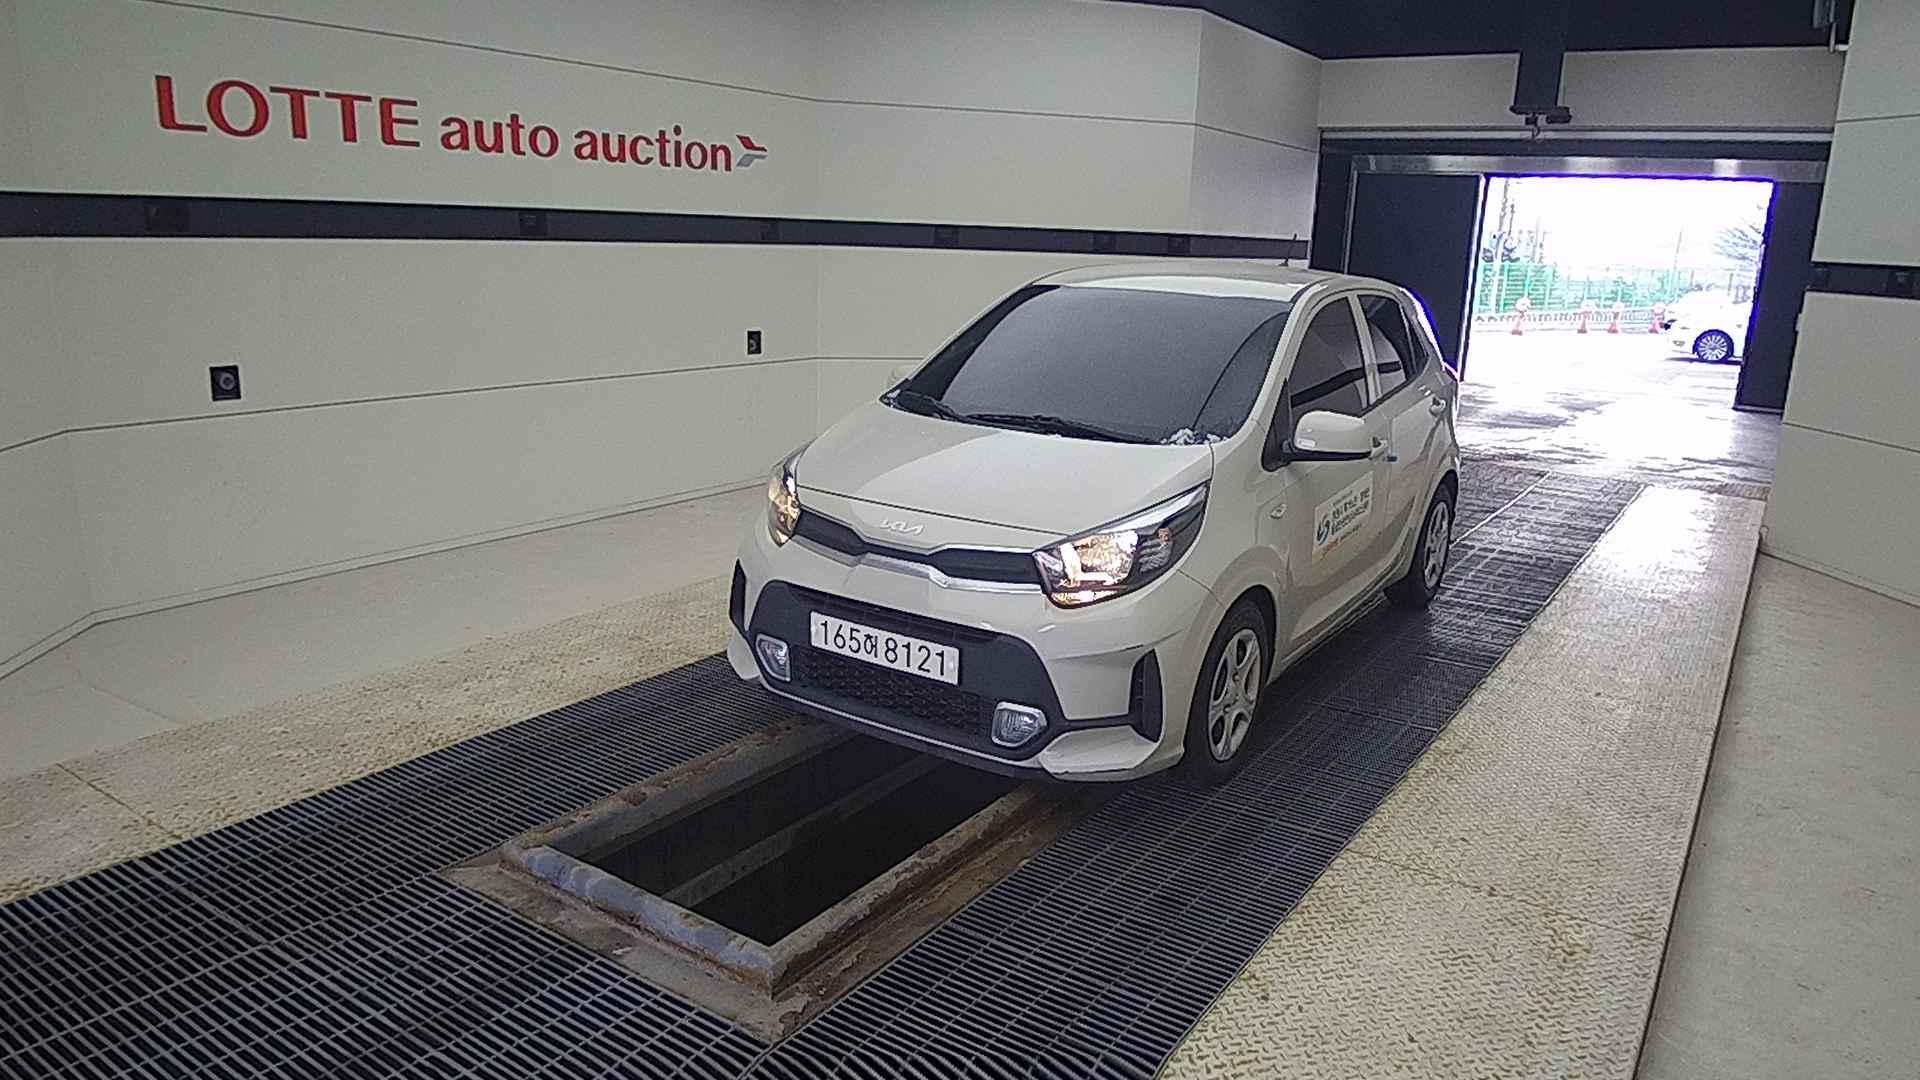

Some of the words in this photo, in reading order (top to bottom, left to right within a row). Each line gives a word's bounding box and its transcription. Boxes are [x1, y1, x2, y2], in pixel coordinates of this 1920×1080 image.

[155, 75, 421, 147] LOTTE
[440, 113, 560, 158] auto
[574, 125, 733, 172] auction
